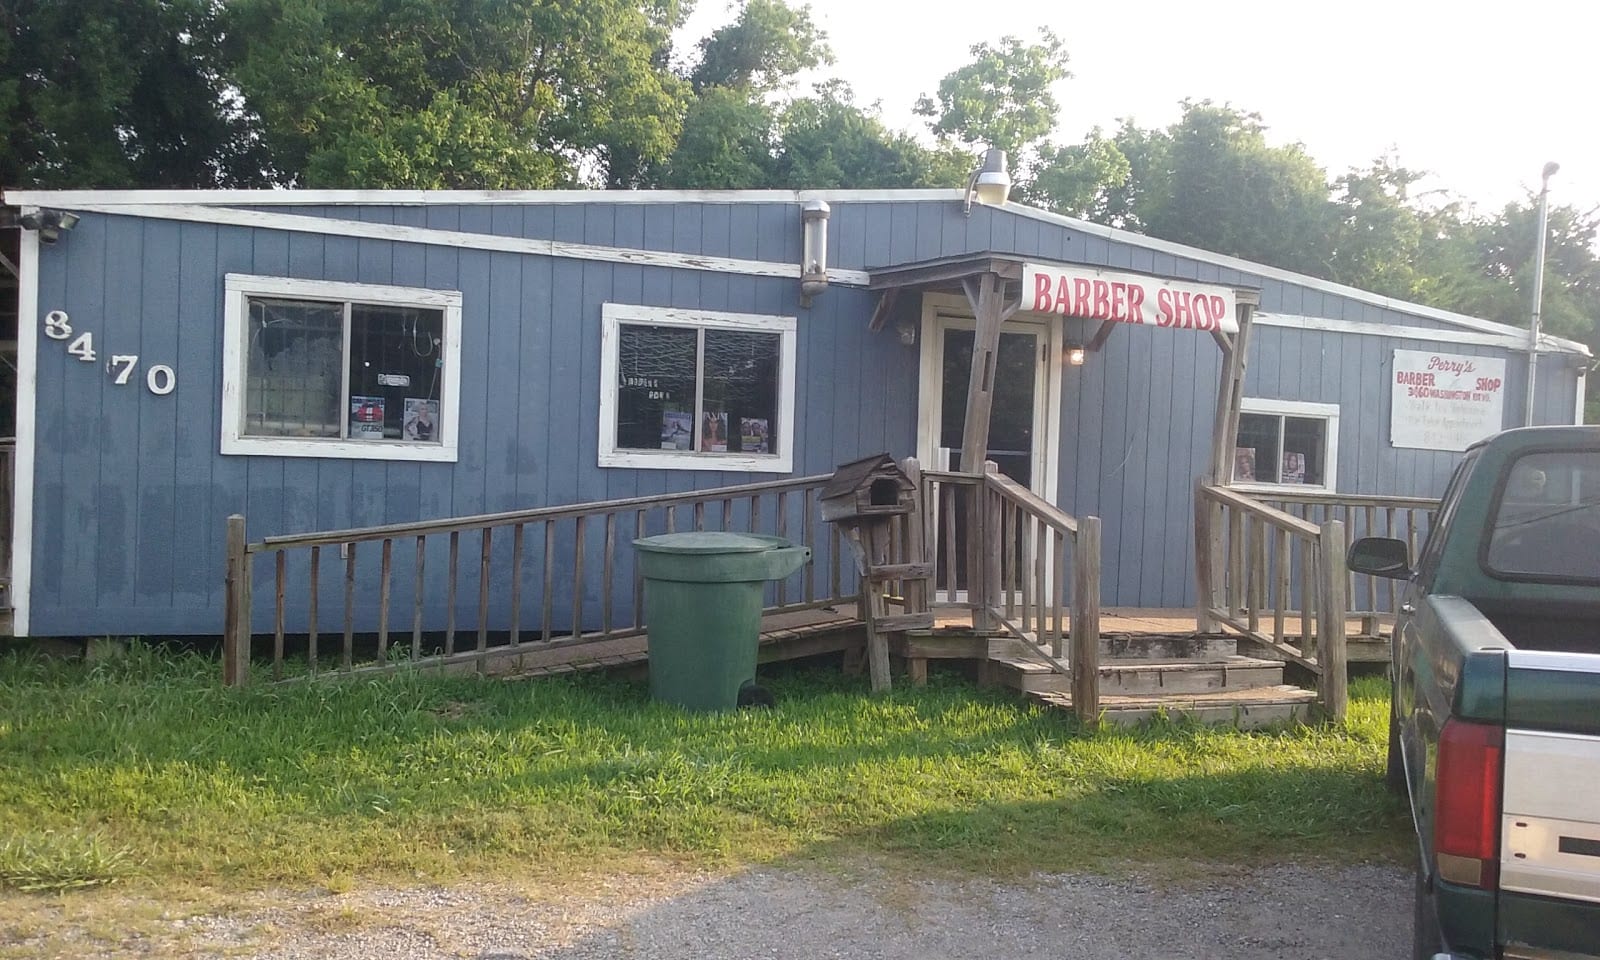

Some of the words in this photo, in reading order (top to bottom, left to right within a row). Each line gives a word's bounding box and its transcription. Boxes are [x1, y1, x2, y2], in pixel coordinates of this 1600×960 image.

[1032, 272, 1145, 325] BARBER
[1155, 288, 1226, 333] SHOP
[44, 310, 176, 395] 8470
[1428, 355, 1476, 377] Perry's
[1396, 371, 1436, 387] BARBER
[1475, 377, 1501, 392] SHOP
